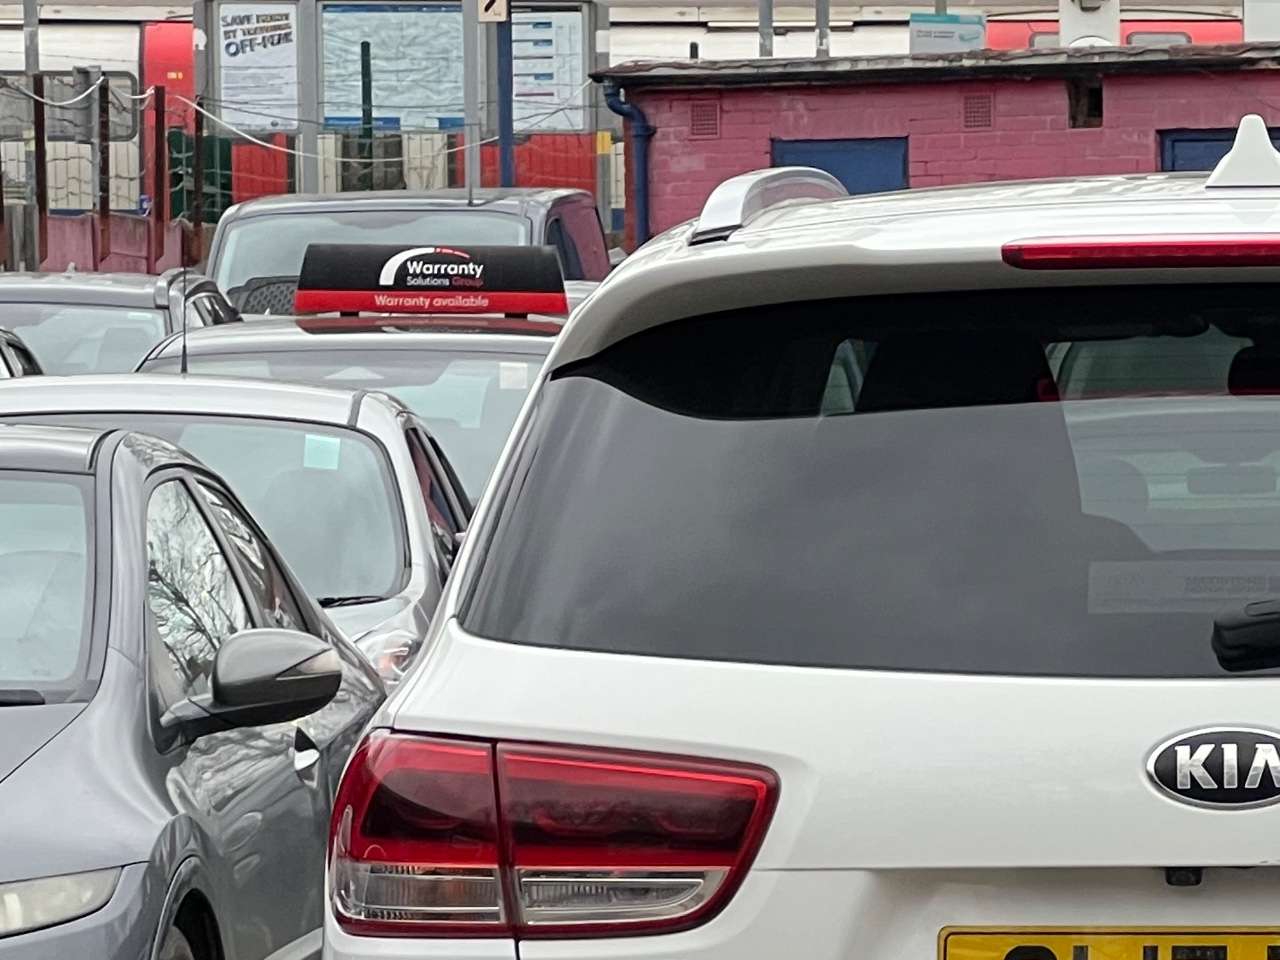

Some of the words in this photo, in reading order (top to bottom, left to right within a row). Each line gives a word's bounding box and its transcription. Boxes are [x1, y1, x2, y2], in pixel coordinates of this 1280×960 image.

[406, 260, 484, 279] Warranty
[406, 276, 450, 286] Solutions
[374, 294, 431, 309] Warranty
[432, 295, 489, 307] available
